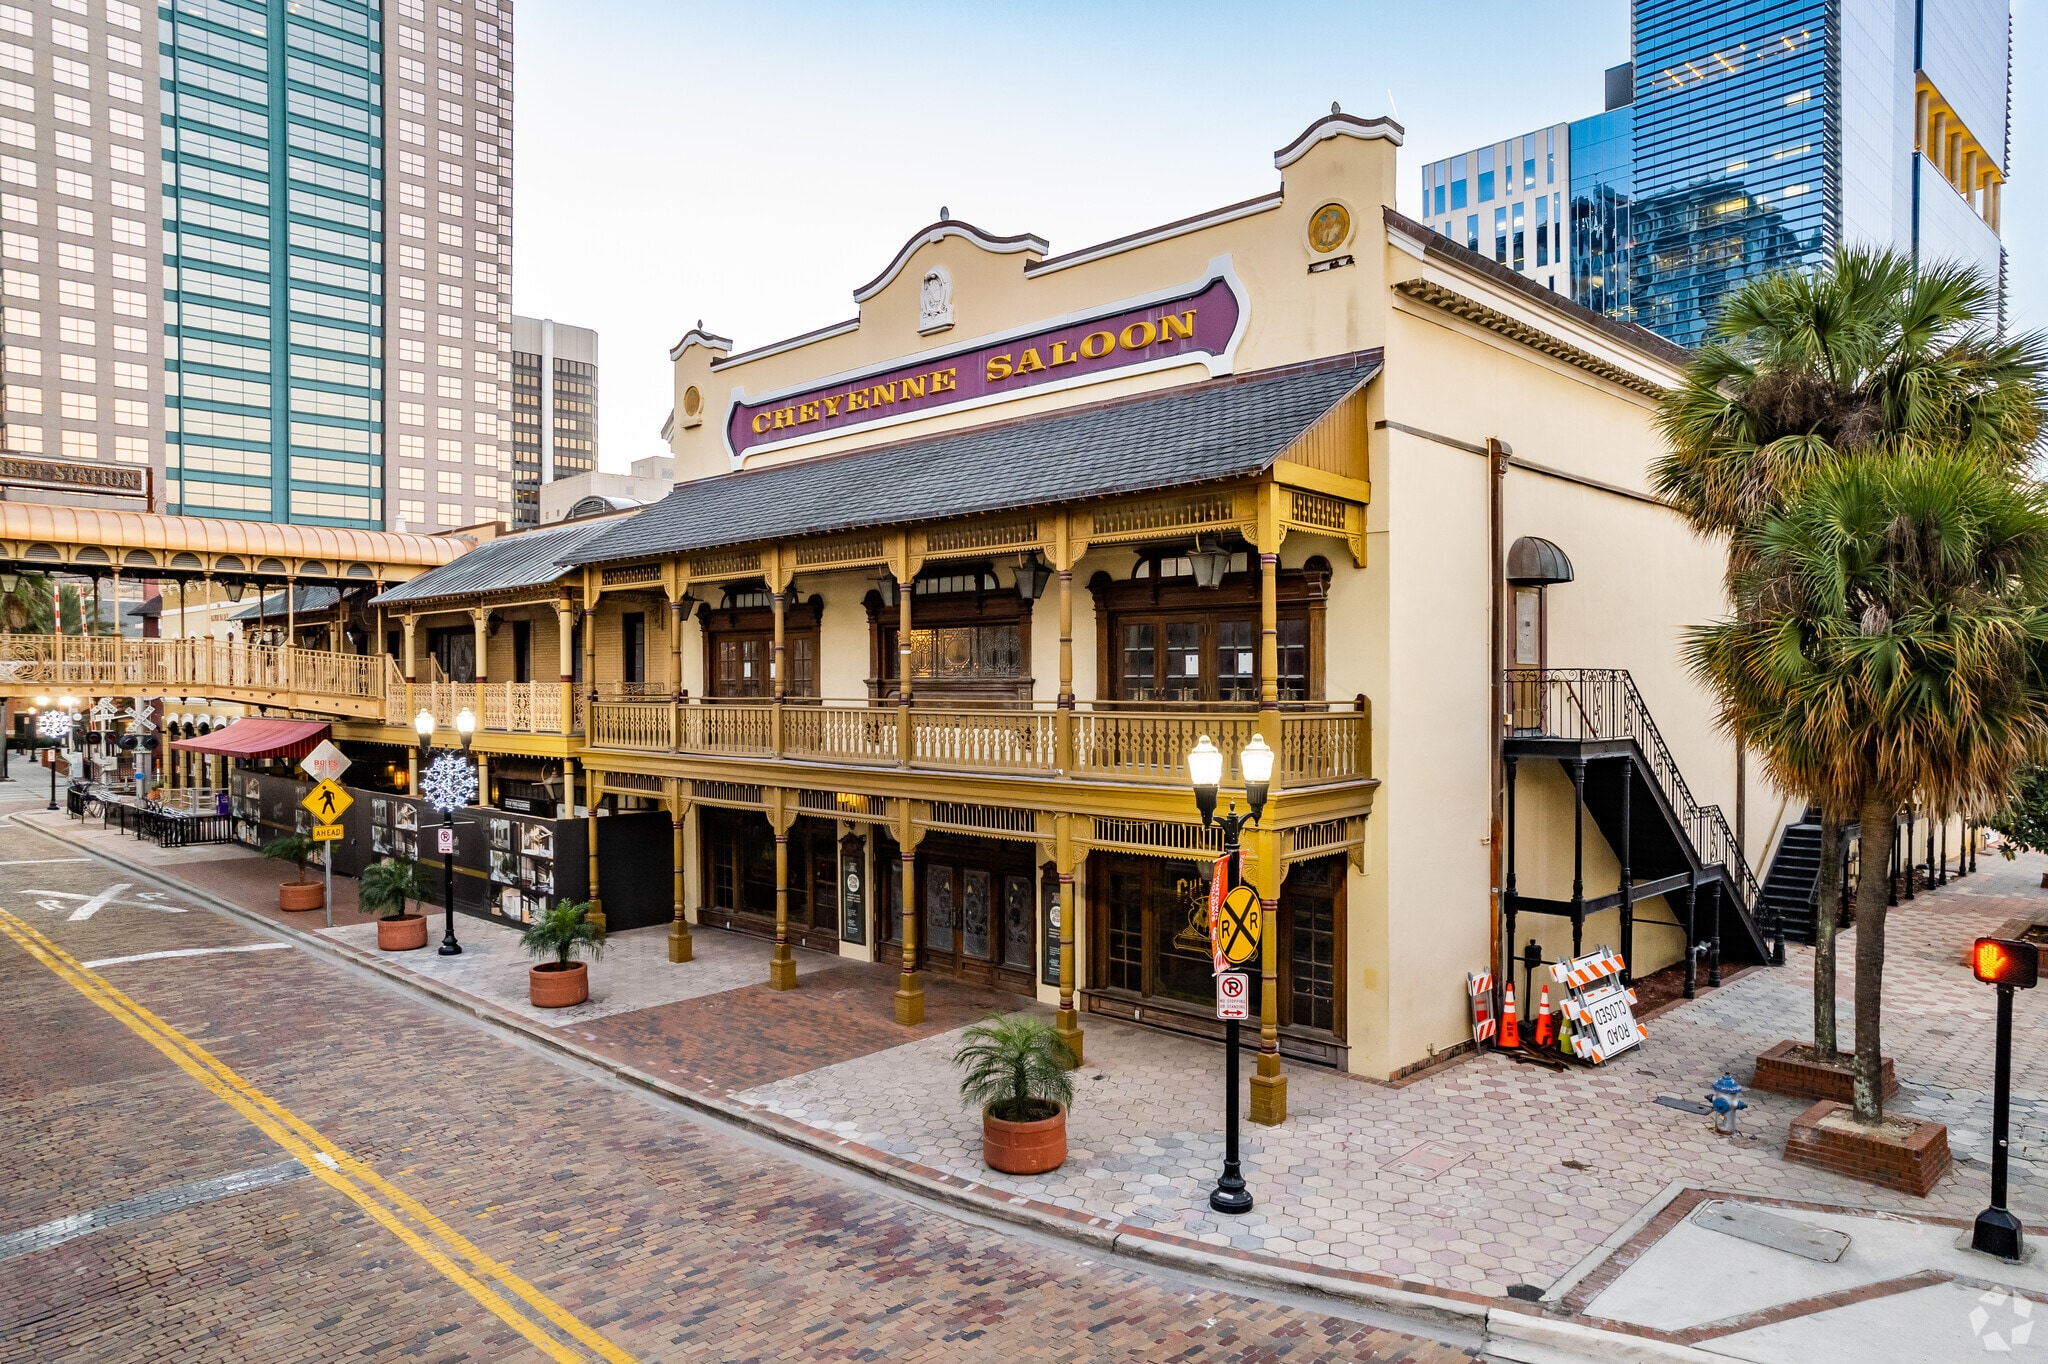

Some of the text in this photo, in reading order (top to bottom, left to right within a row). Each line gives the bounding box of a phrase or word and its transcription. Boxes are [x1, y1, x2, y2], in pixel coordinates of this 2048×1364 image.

[752, 309, 1197, 434] CHEYENNE SALOON
[53, 465, 136, 488] STATION
[316, 828, 340, 837] AHEAD
[1214, 861, 1224, 920] DOWNTOWN
[1222, 920, 1230, 938] R
[1250, 912, 1258, 930] R
[1595, 1000, 1627, 1026] CLOSED
[1607, 1022, 1630, 1045] ROAD
